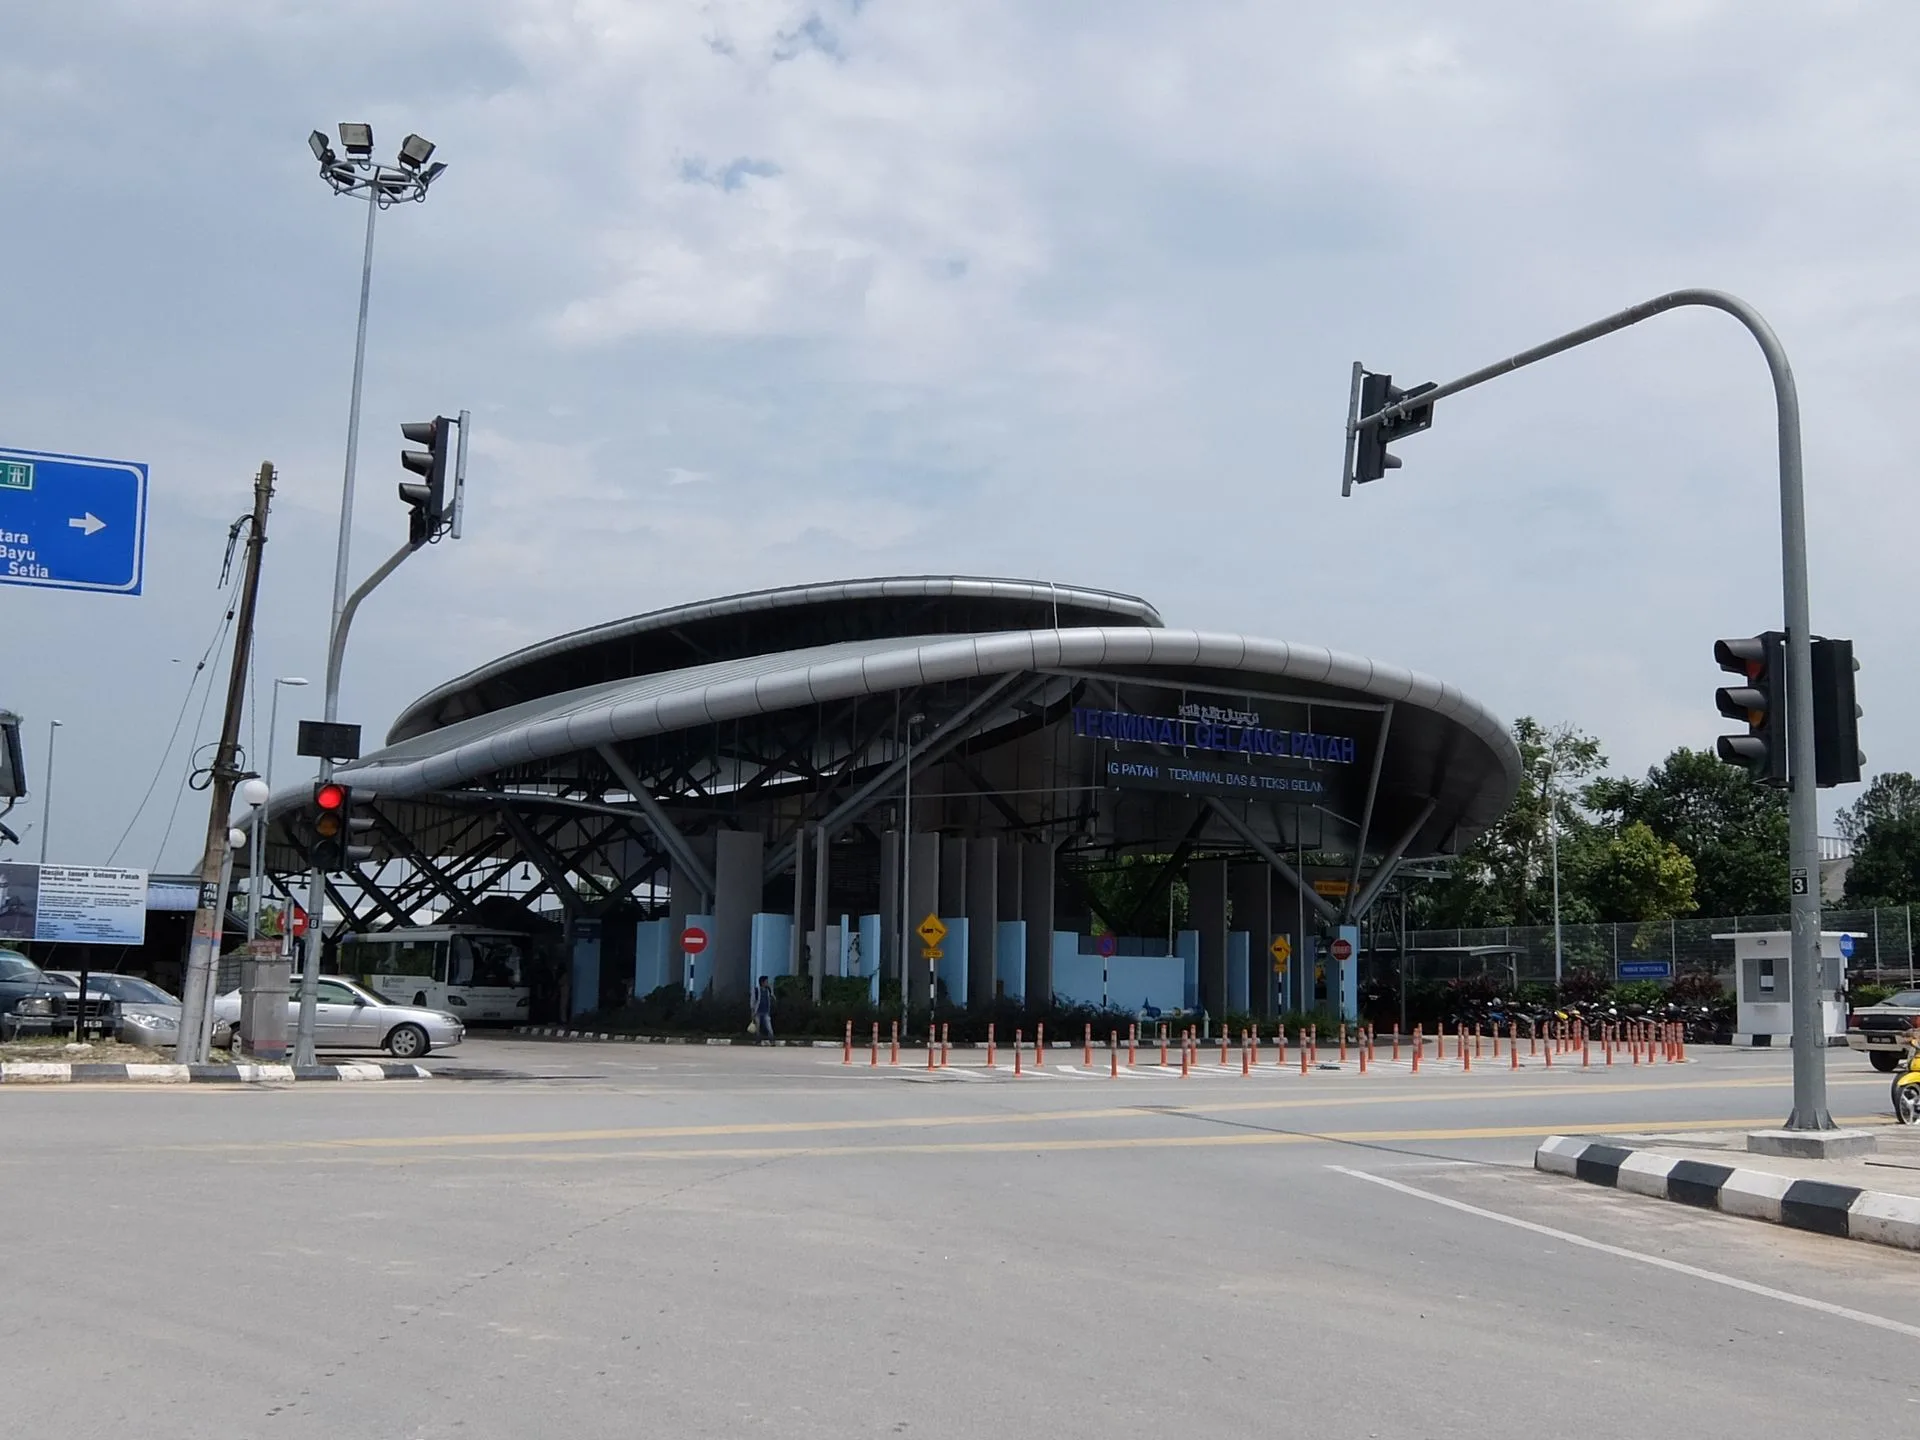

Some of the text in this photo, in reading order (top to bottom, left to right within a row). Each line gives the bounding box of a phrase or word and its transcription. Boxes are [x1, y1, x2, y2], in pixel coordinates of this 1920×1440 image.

[0, 544, 36, 562] Bayu
[8, 560, 49, 578] Setia
[1072, 706, 1355, 764] TERMINAL GELANG PATAH
[1121, 763, 1159, 779] PATAH
[1167, 767, 1224, 785] TERMINAL
[1259, 776, 1288, 791] TEKSI
[1793, 878, 1804, 893] 3
